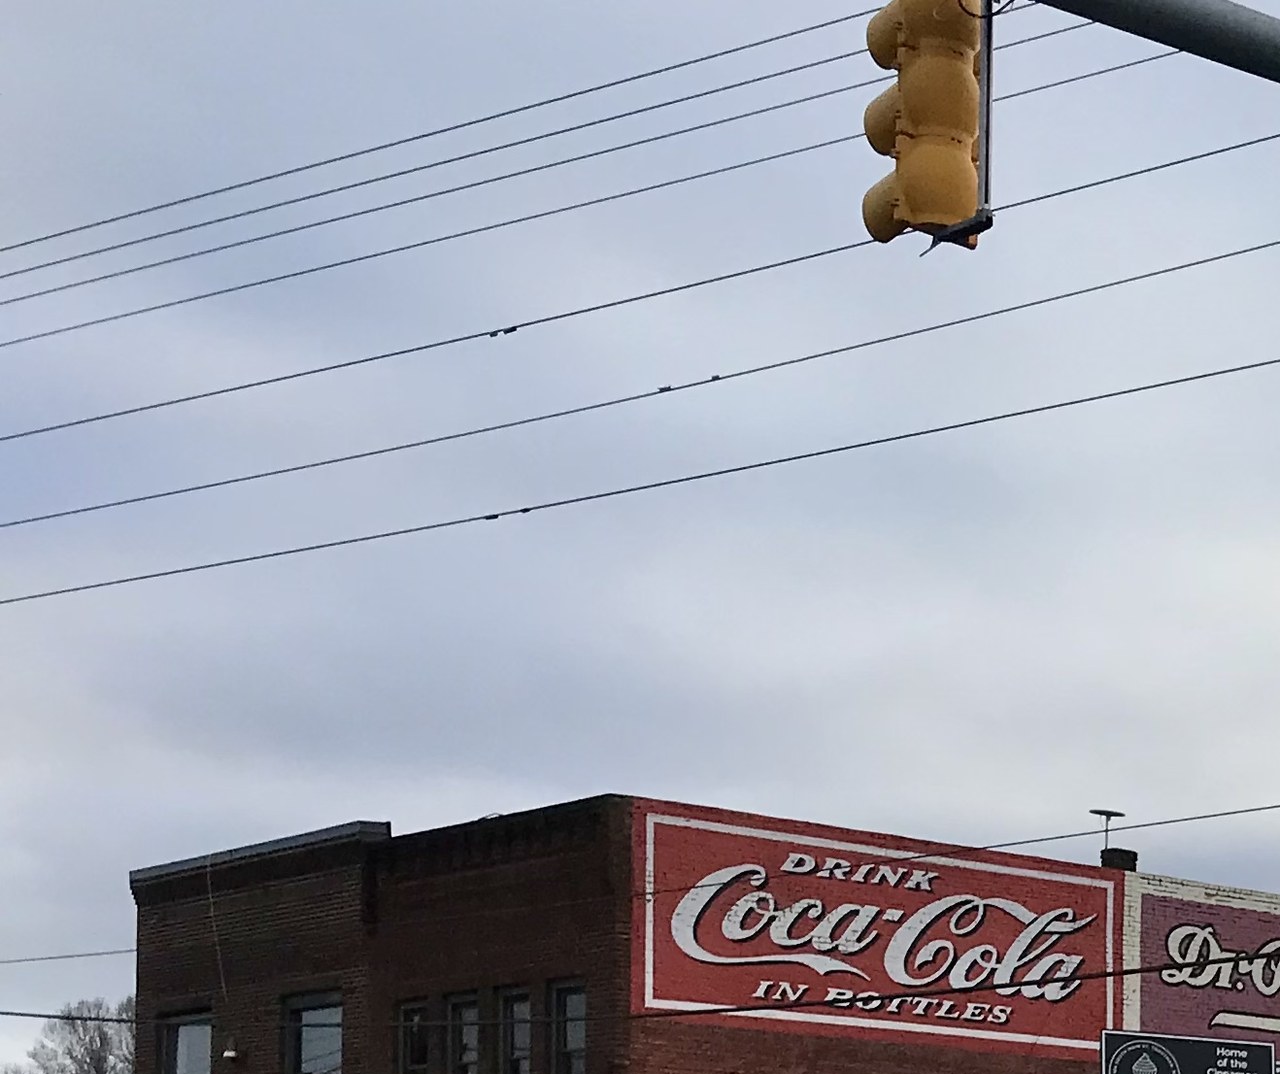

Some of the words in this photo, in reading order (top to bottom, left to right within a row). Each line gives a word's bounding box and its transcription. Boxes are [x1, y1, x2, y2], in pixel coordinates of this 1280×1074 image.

[780, 852, 940, 892] DRINK
[670, 863, 1098, 1001] Coca-Cola
[1161, 922, 1244, 992] Dr.
[752, 980, 808, 1002] IN
[824, 986, 1013, 1024] BOTTLES
[1216, 1047, 1248, 1058] Home
[1216, 1058, 1228, 1067] of
[1230, 1058, 1248, 1069] the
